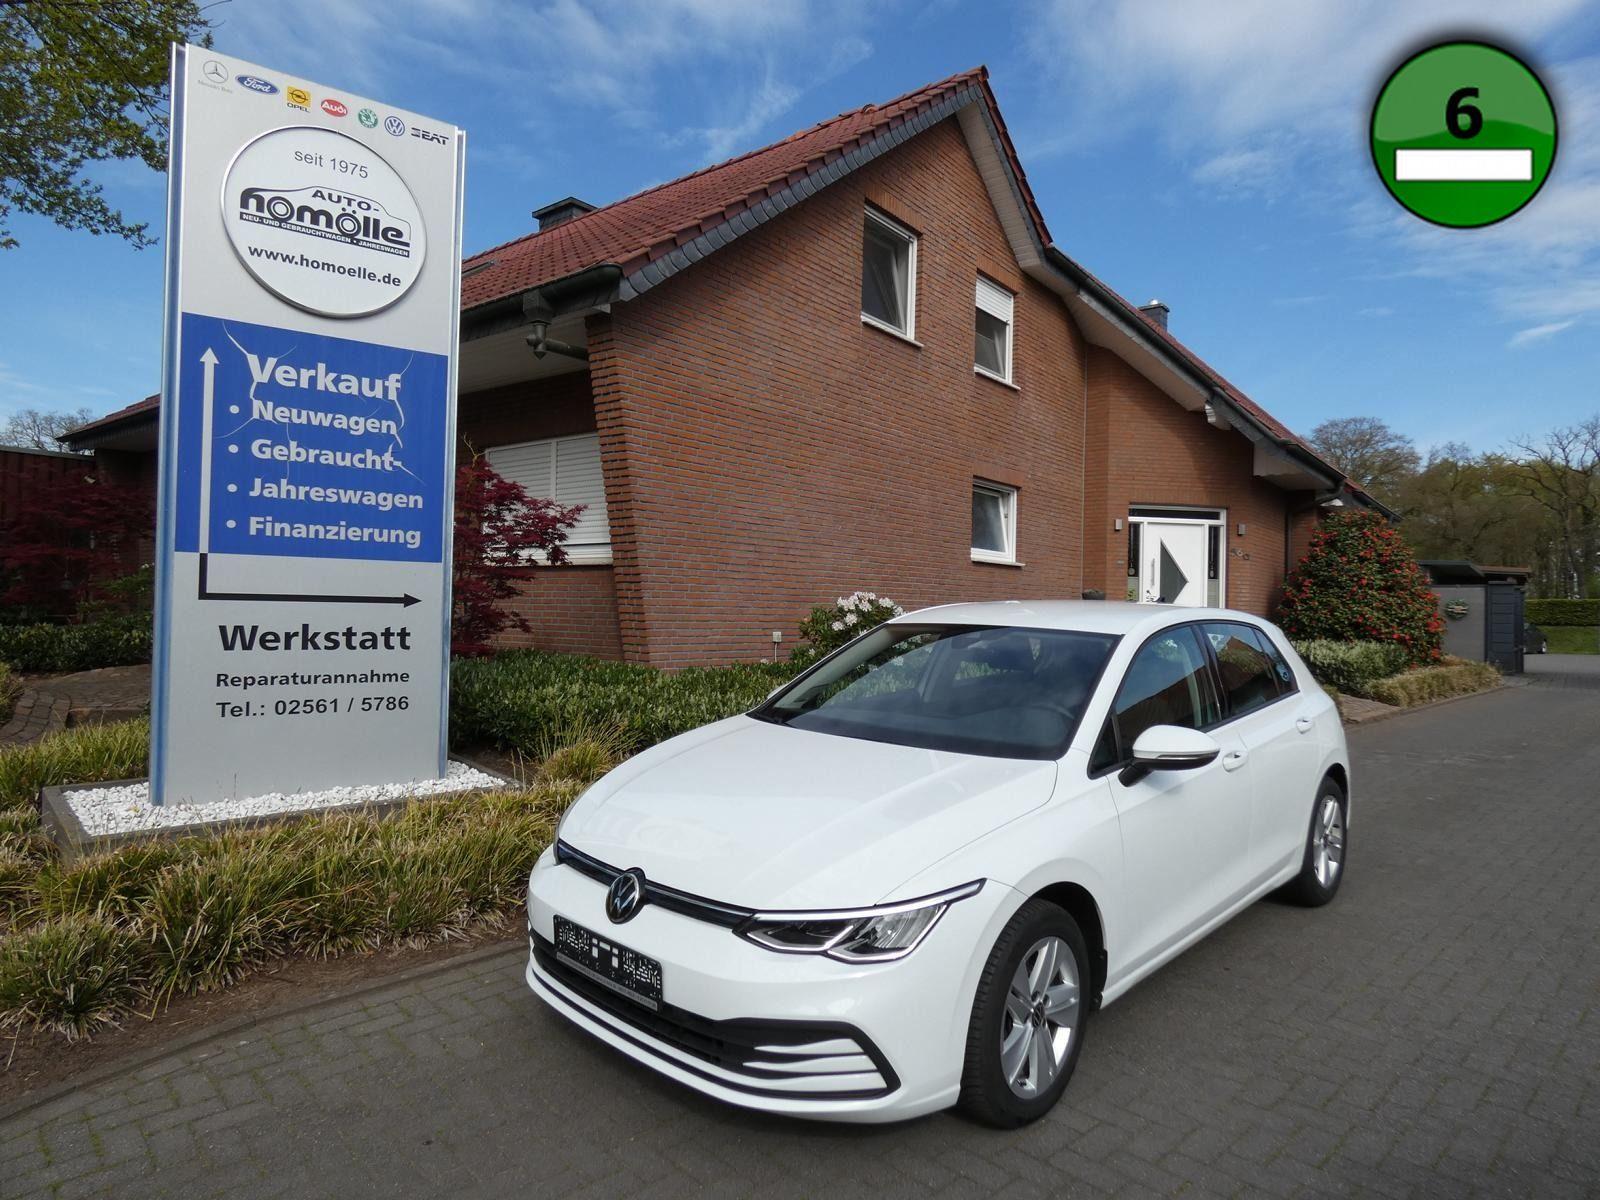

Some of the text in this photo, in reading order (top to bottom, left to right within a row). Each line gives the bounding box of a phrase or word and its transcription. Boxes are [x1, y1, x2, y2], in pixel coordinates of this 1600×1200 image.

[244, 78, 271, 92] Ford
[287, 102, 311, 113] OPEL
[321, 101, 347, 115] Audi
[411, 127, 449, 145] SEAT
[330, 157, 369, 179] 1975
[263, 218, 280, 228] UND
[281, 222, 351, 244] GEBRAUCHTWAGEN
[358, 240, 409, 257] JAHRESWAGEN
[248, 246, 402, 287] www.homoelle.de
[247, 354, 402, 401] Verkauf
[252, 399, 397, 436] Neuwagen
[249, 478, 424, 512] Jahreswagen
[249, 516, 422, 549] Finanzierung
[218, 623, 411, 651] Werkstatt
[215, 669, 410, 690] Reparaturannahme
[216, 701, 266, 718] Tel.:
[274, 698, 339, 716] 02561
[361, 695, 410, 712] 5786
